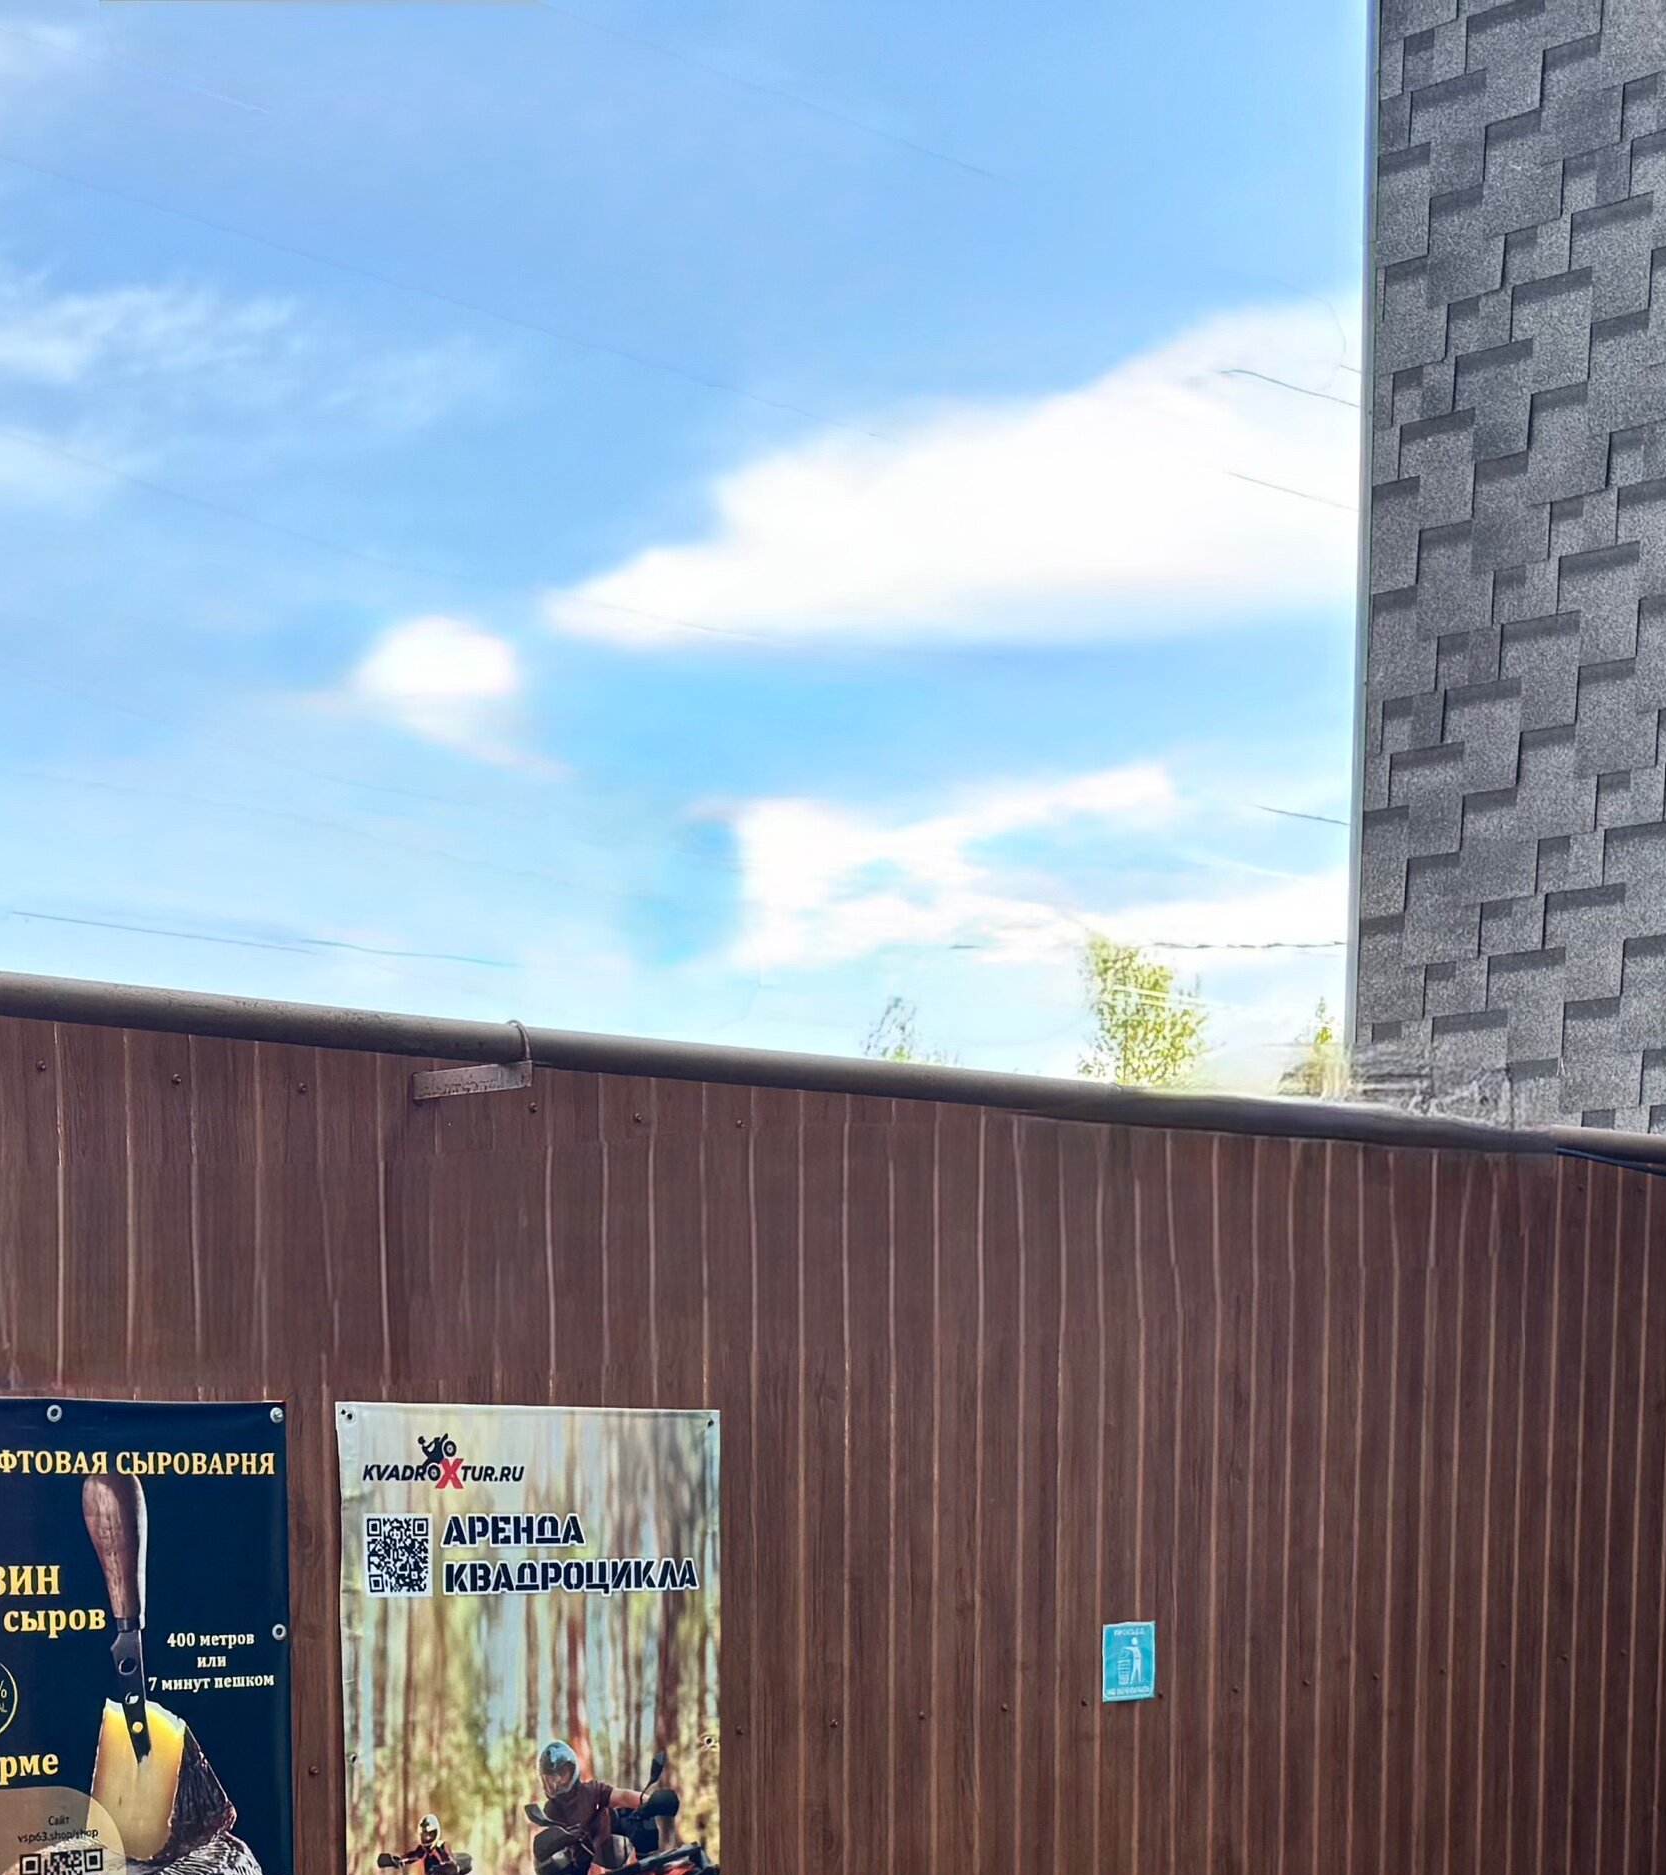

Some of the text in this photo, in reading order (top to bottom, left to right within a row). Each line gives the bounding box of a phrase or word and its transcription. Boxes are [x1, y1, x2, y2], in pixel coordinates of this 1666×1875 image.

[115, 1451, 276, 1477] СЫРОВАРНЯ
[363, 1457, 525, 1491] KVADROXTUR.RU
[442, 1514, 585, 1547] АРЕНДА
[443, 1558, 699, 1596] КВАДРОЦИКЛА
[4, 1608, 107, 1639] сыров
[167, 1632, 255, 1650] 400 метров
[197, 1655, 227, 1669] или
[148, 1673, 275, 1694] 7 минут пешком
[48, 1815, 70, 1826] Сайт
